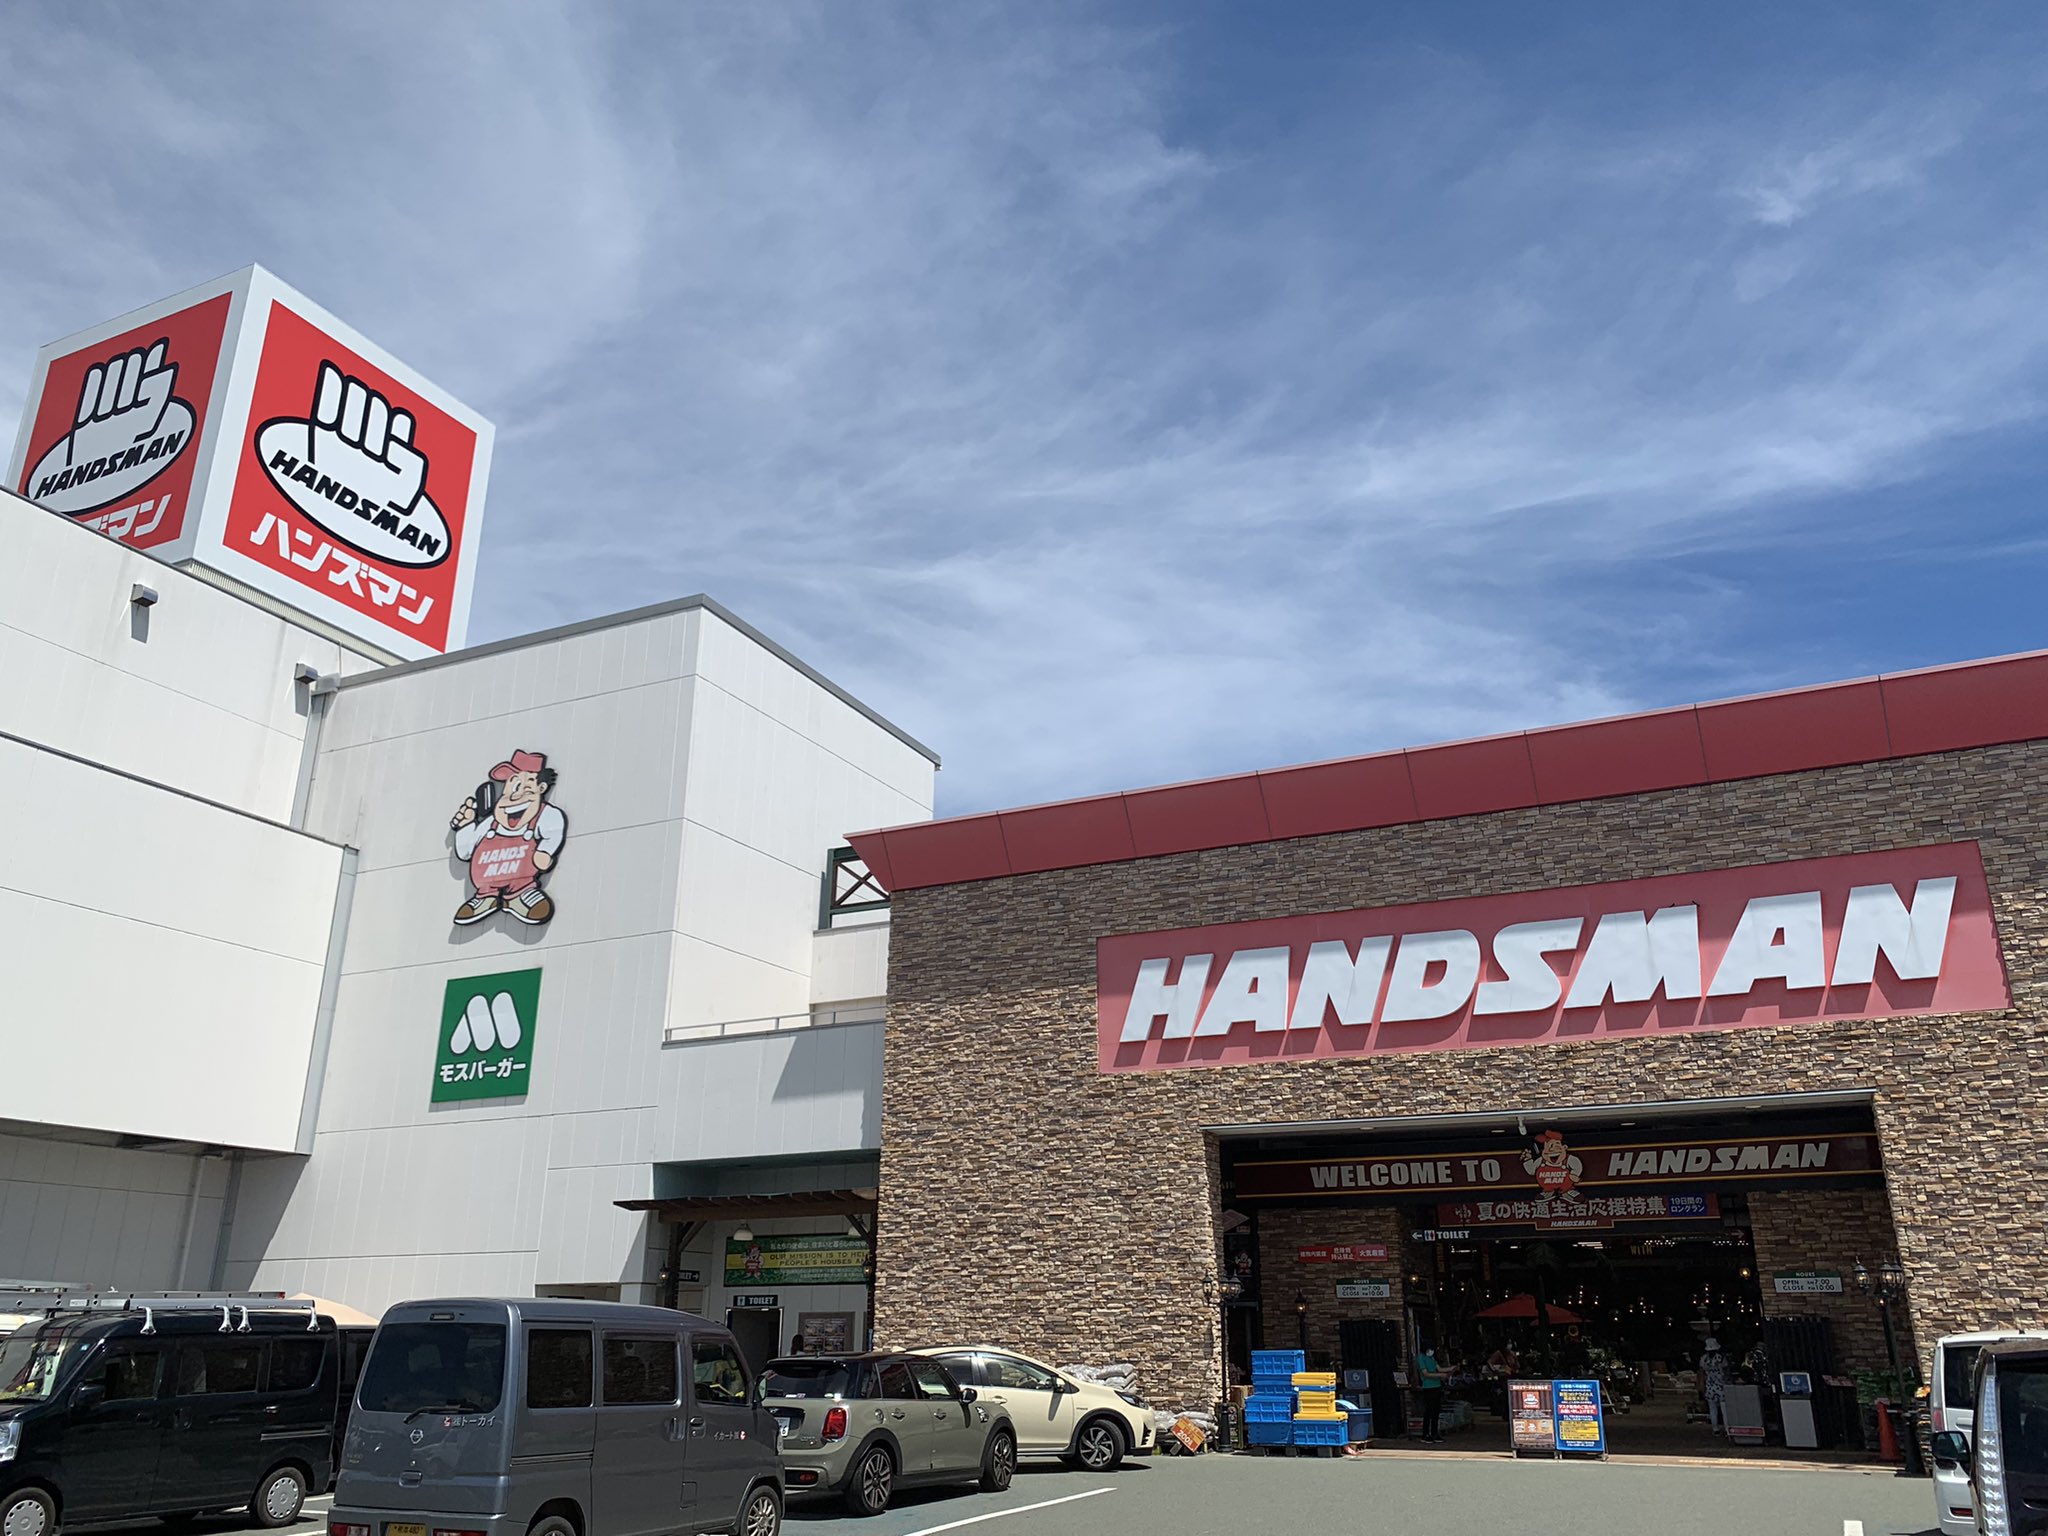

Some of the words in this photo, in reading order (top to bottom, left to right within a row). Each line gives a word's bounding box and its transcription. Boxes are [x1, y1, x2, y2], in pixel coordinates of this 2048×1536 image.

[34, 429, 185, 500] HANDSMAN
[269, 449, 441, 556] HANDSMAN
[83, 494, 172, 541] ズマン
[250, 512, 434, 624] ハンズマン
[478, 844, 529, 865] HANDS
[482, 859, 522, 878] MAN
[1120, 875, 1957, 1043] HANDSMAN
[440, 1058, 527, 1083] モスバーガー
[1608, 1142, 1830, 1176] HANDSMAN
[1309, 1161, 1452, 1189] WELCOME
[1461, 1158, 1502, 1182] TO
[1538, 1171, 1568, 1179] HANDS
[1476, 1195, 1667, 1222] 夏の快適生活応援特集
[1436, 1230, 1471, 1240] TOILET
[1550, 1219, 1598, 1228] HANDSMAN
[749, 1296, 775, 1305] TOILET
